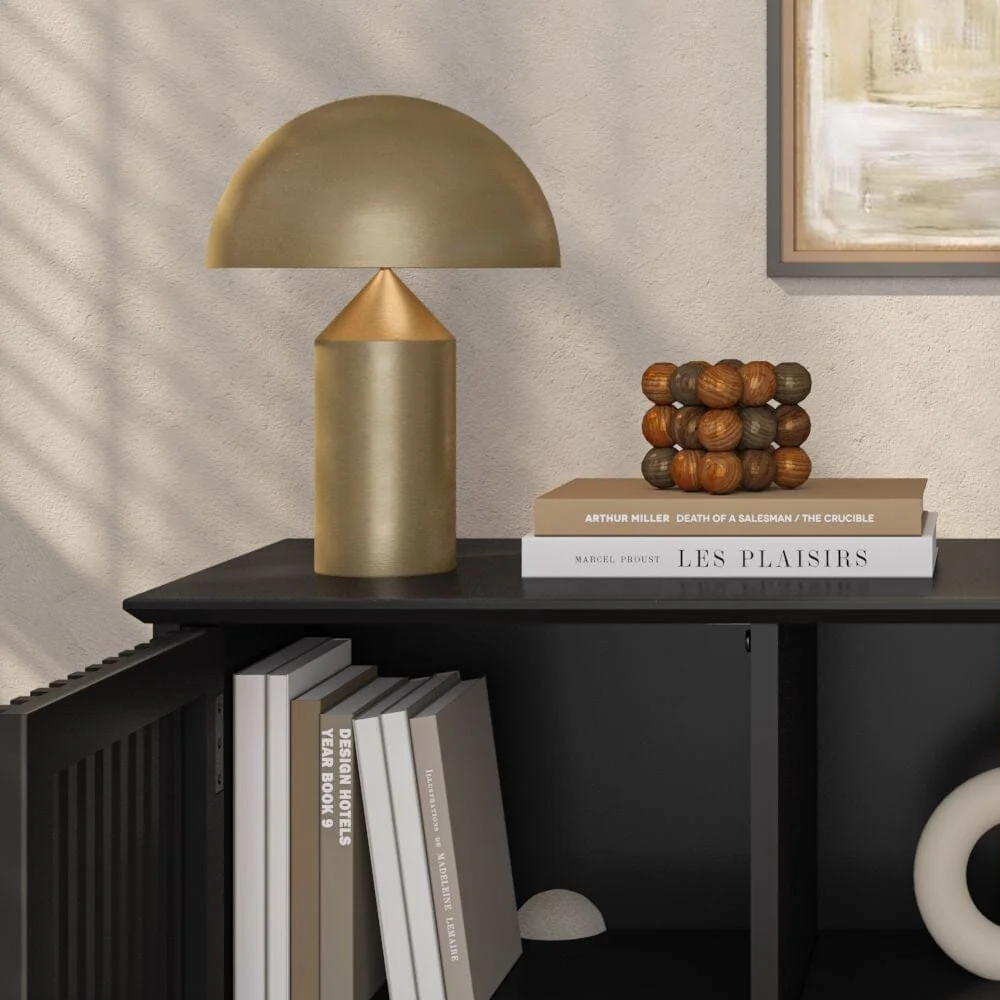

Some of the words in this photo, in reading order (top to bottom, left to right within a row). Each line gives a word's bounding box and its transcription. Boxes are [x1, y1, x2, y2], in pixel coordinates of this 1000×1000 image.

[584, 513, 628, 523] ARTHUR
[630, 513, 670, 523] MILLER
[676, 513, 711, 523] DEATH
[711, 513, 727, 523] OF
[728, 513, 737, 523] A
[738, 513, 792, 523] SALESMAN
[801, 513, 822, 523] THE
[823, 513, 875, 523] CRUCIBLE
[575, 555, 615, 564] MARCEL
[620, 555, 660, 564] PROUST
[678, 549, 726, 568] LES
[741, 549, 868, 568] PLAISIRS
[321, 728, 334, 768] YEAR
[339, 728, 352, 785] DESIGN
[321, 772, 334, 815] BOOK
[321, 818, 334, 829] 9
[339, 789, 352, 847] HOTELS
[437, 853, 452, 911] MADELEINE
[445, 917, 459, 962] LEMAIRE
